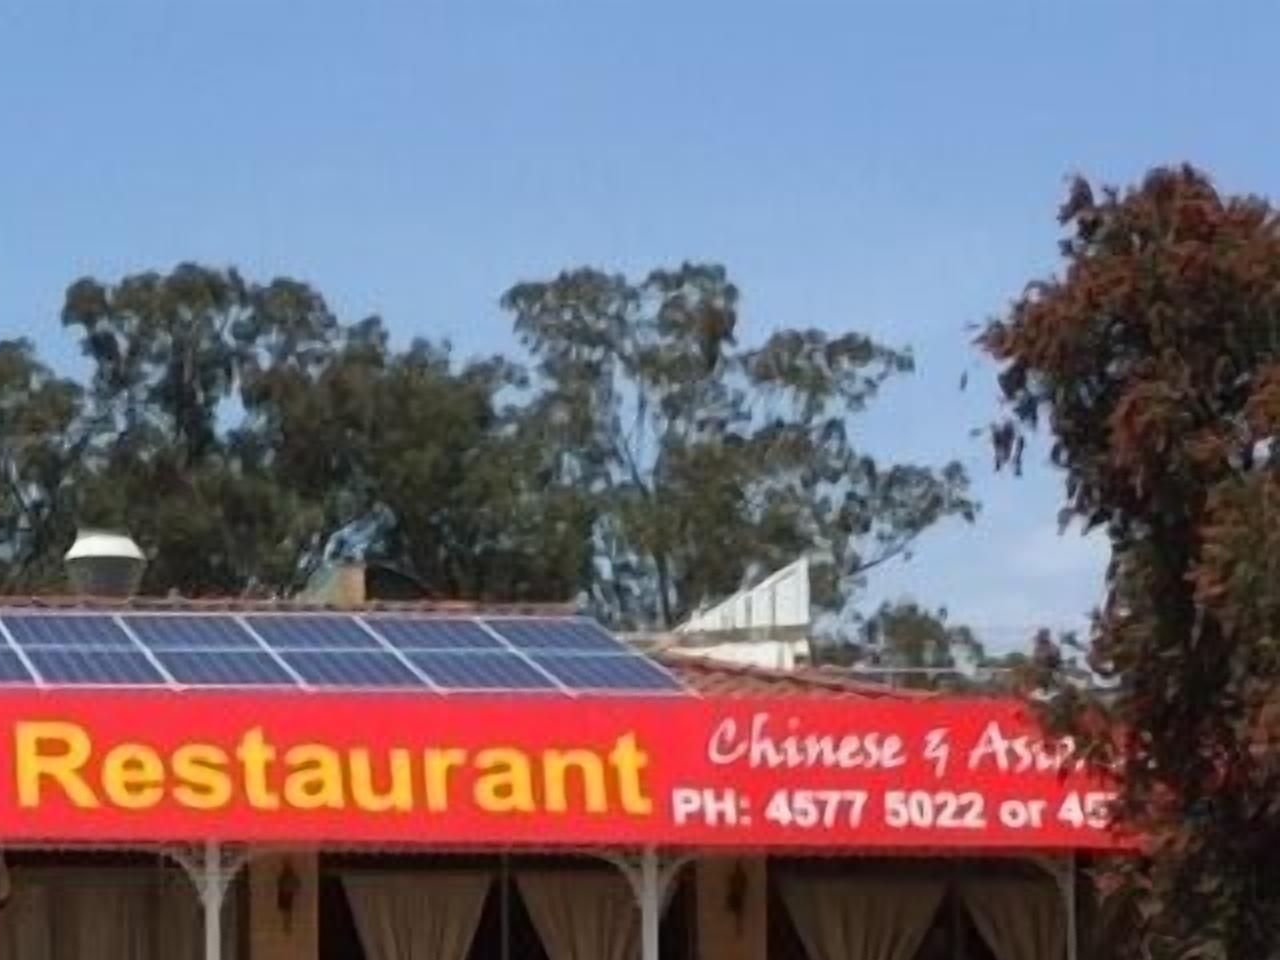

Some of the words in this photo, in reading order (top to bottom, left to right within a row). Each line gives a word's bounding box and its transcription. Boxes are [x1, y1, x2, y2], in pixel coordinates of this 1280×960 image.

[14, 720, 652, 815] Restaurant
[707, 712, 906, 769] Chinese
[671, 787, 751, 826] PH:
[764, 789, 869, 828] 4577
[883, 790, 987, 829] 5022
[998, 799, 1047, 829] or
[1057, 790, 1119, 829] 45
